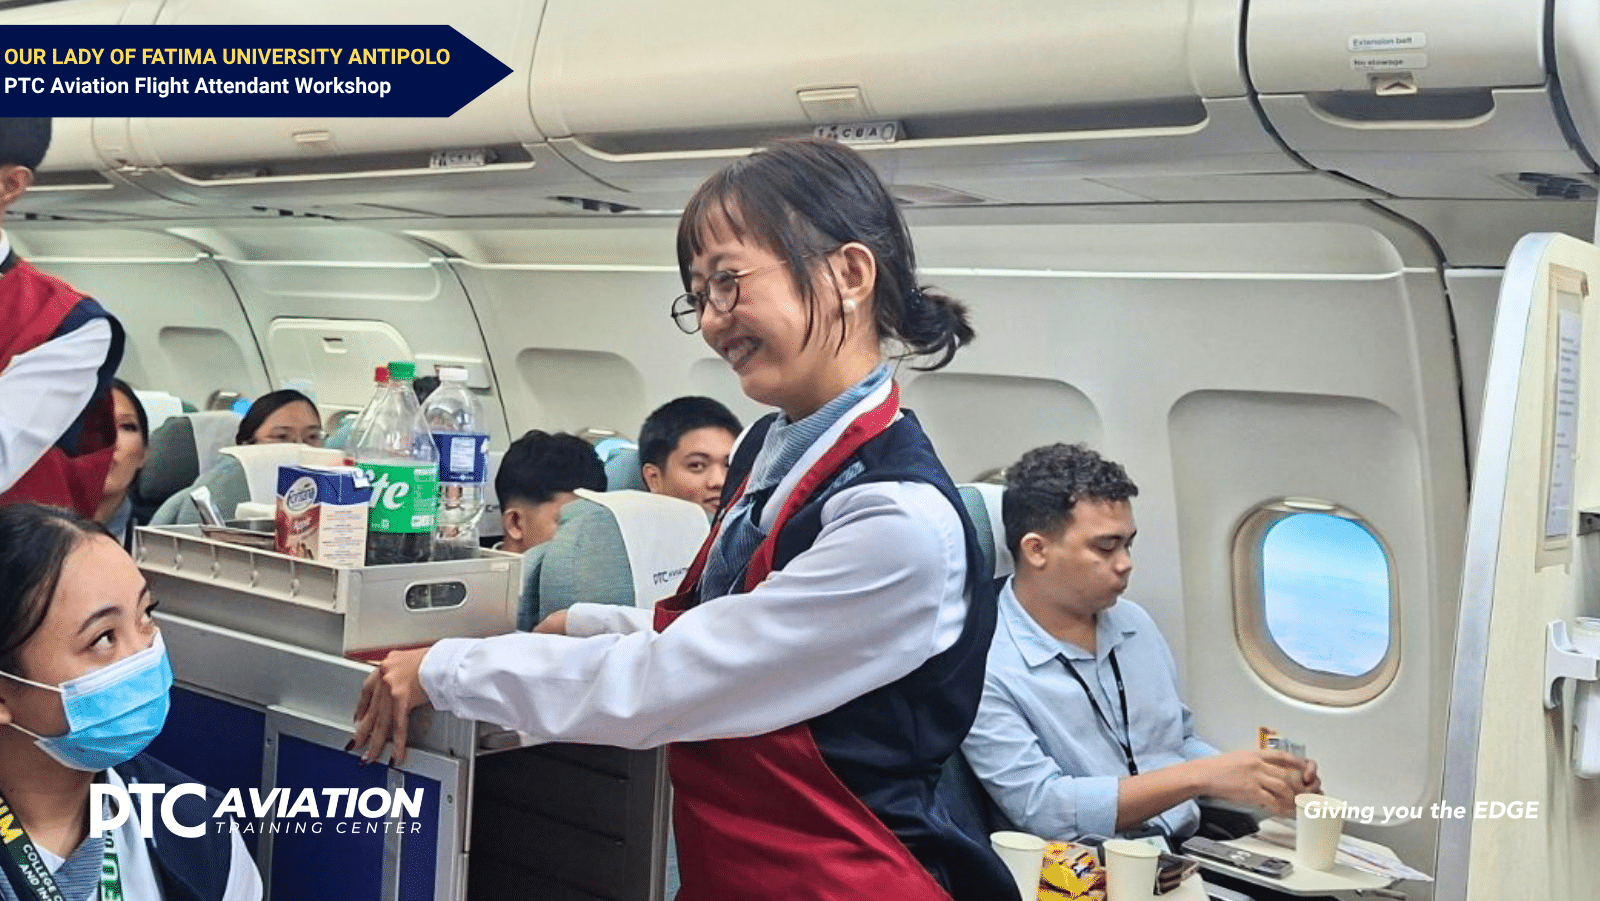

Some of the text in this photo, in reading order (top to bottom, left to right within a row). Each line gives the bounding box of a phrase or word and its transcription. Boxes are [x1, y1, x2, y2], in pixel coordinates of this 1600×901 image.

[1353, 38, 1394, 47] Extension
[18, 863, 40, 886] AND
[23, 843, 58, 893] COLLEGE
